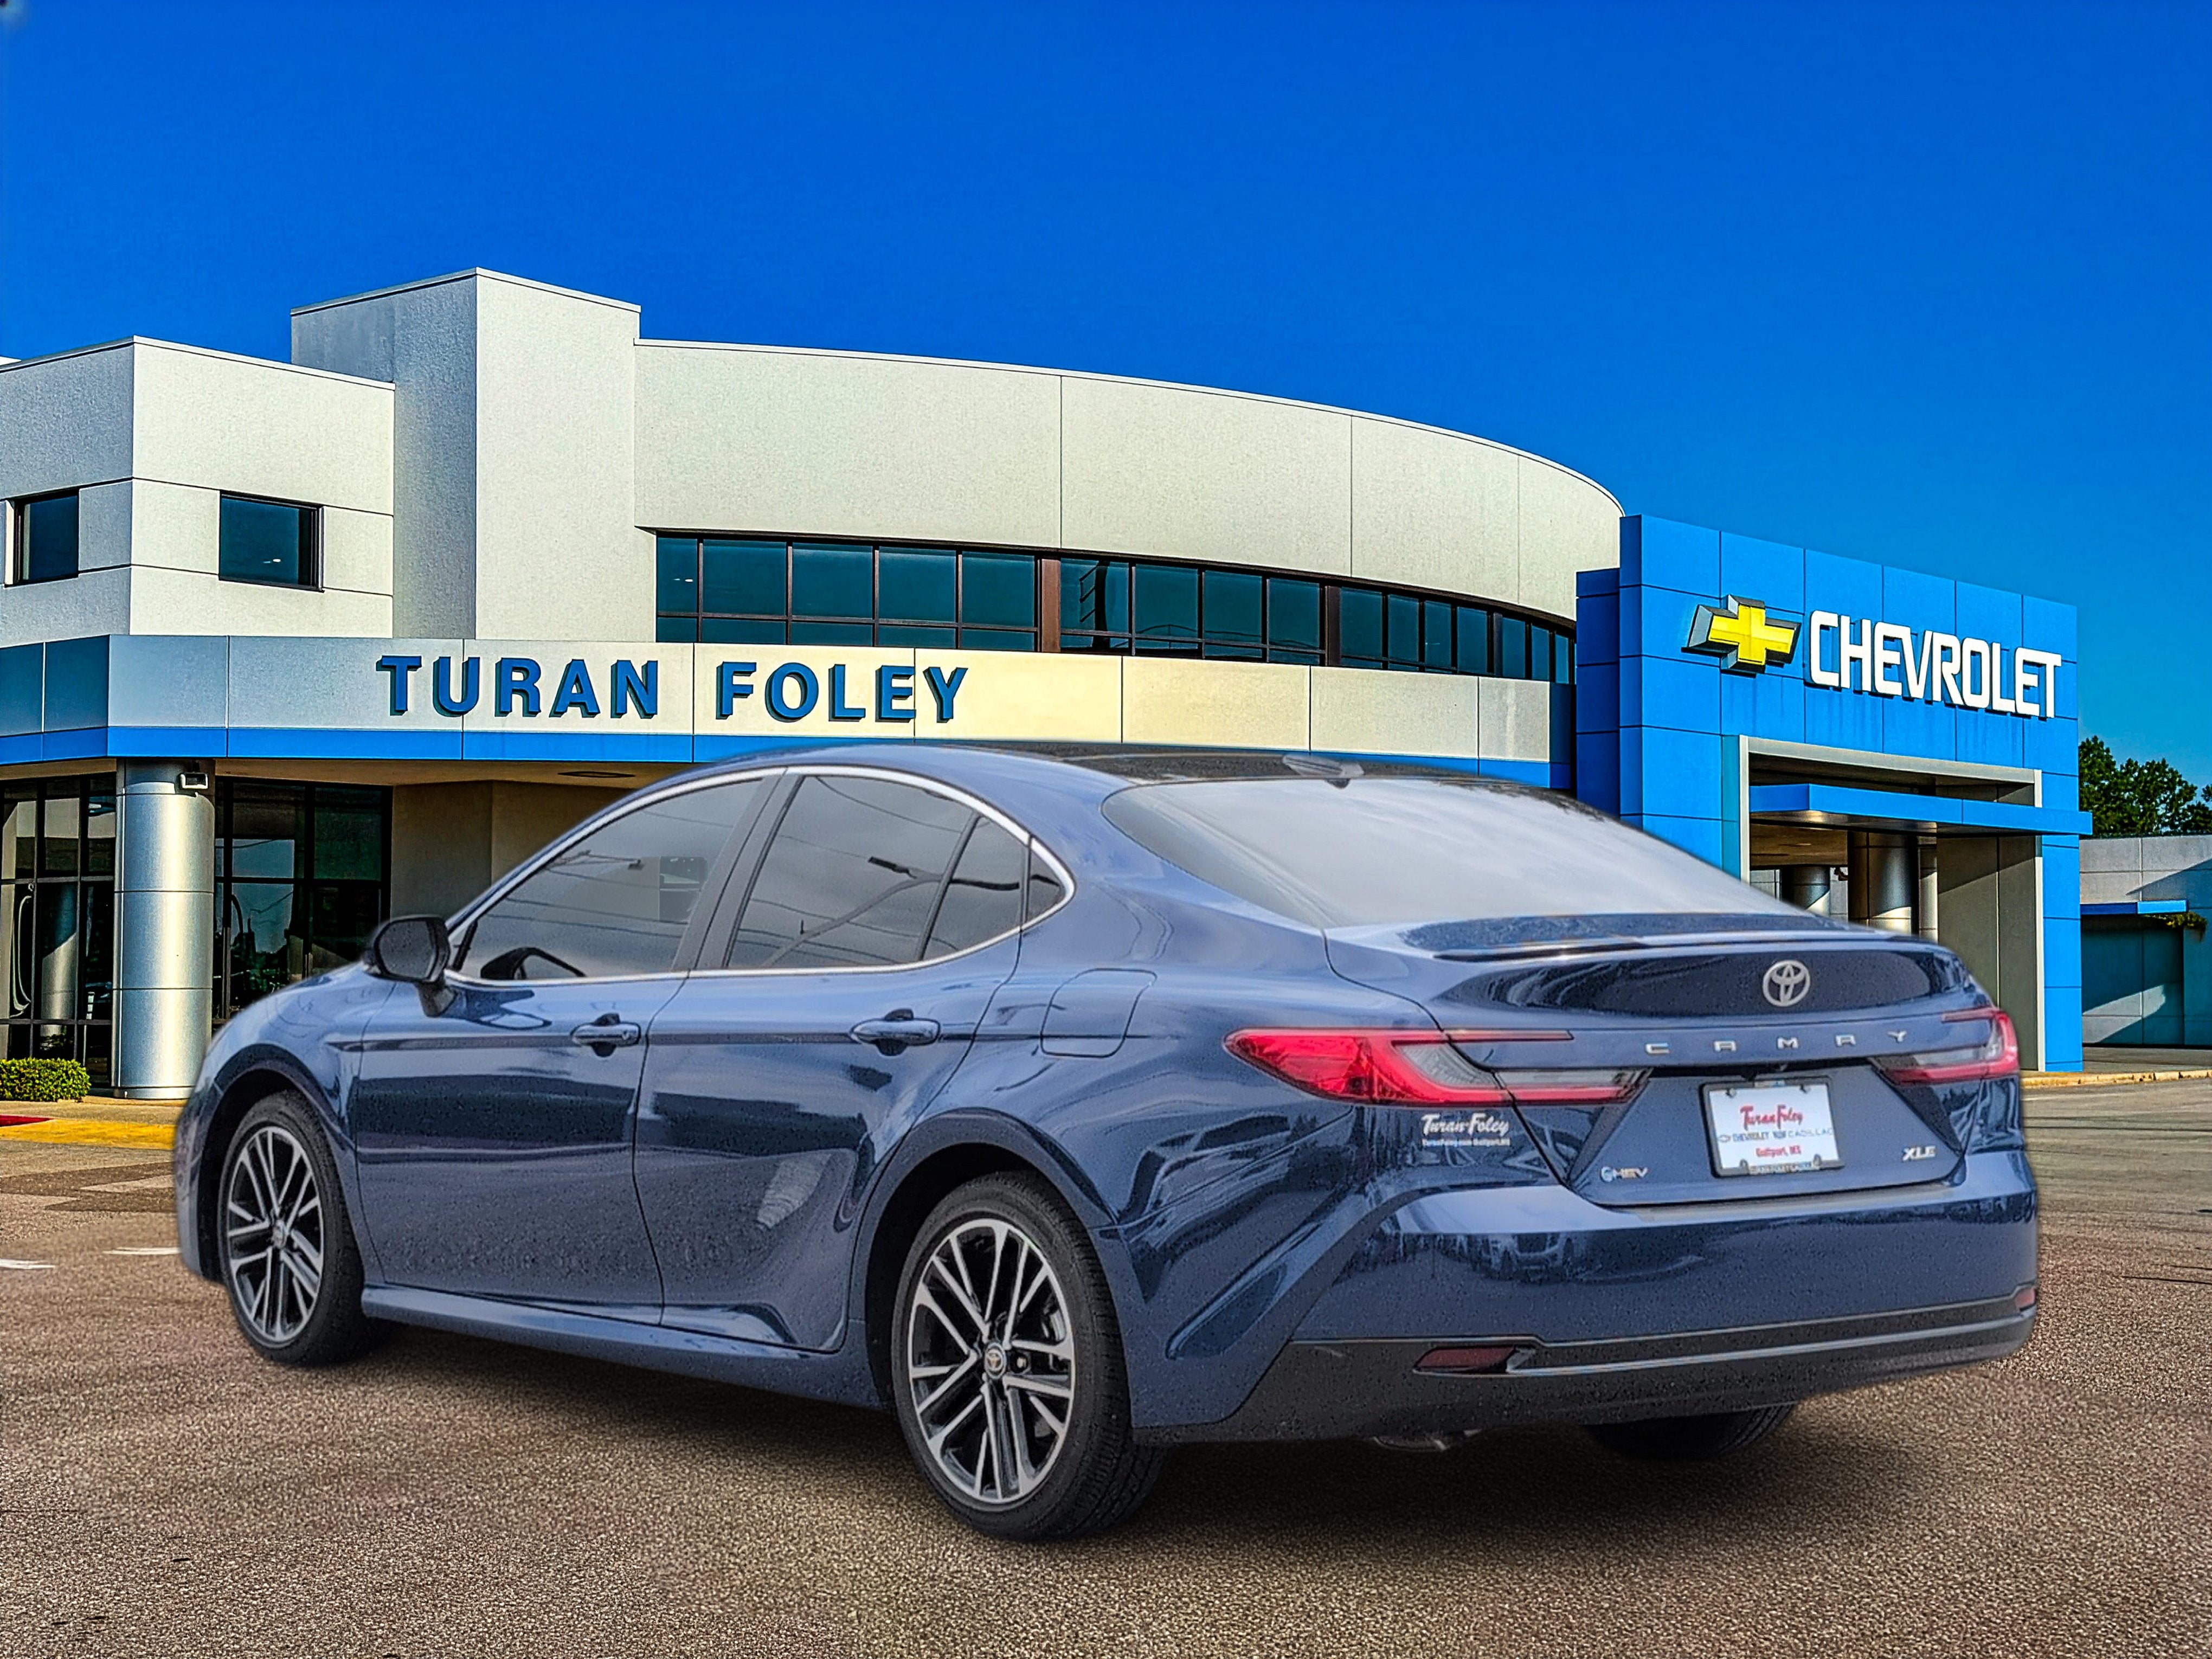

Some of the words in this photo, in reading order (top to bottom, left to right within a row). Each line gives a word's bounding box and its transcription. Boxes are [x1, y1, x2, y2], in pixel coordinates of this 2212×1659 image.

[1808, 610, 2062, 719] CHEVROLET
[377, 655, 658, 718] TURAN
[716, 661, 969, 723] FOLEY
[1645, 1030, 1907, 1054] CAMRY
[1420, 1113, 1465, 1136] Turan
[1467, 1113, 1509, 1137] Foley
[1740, 1105, 1776, 1131] Turan
[1776, 1104, 1803, 1129] Foley
[1902, 1145, 1936, 1161] XLE
